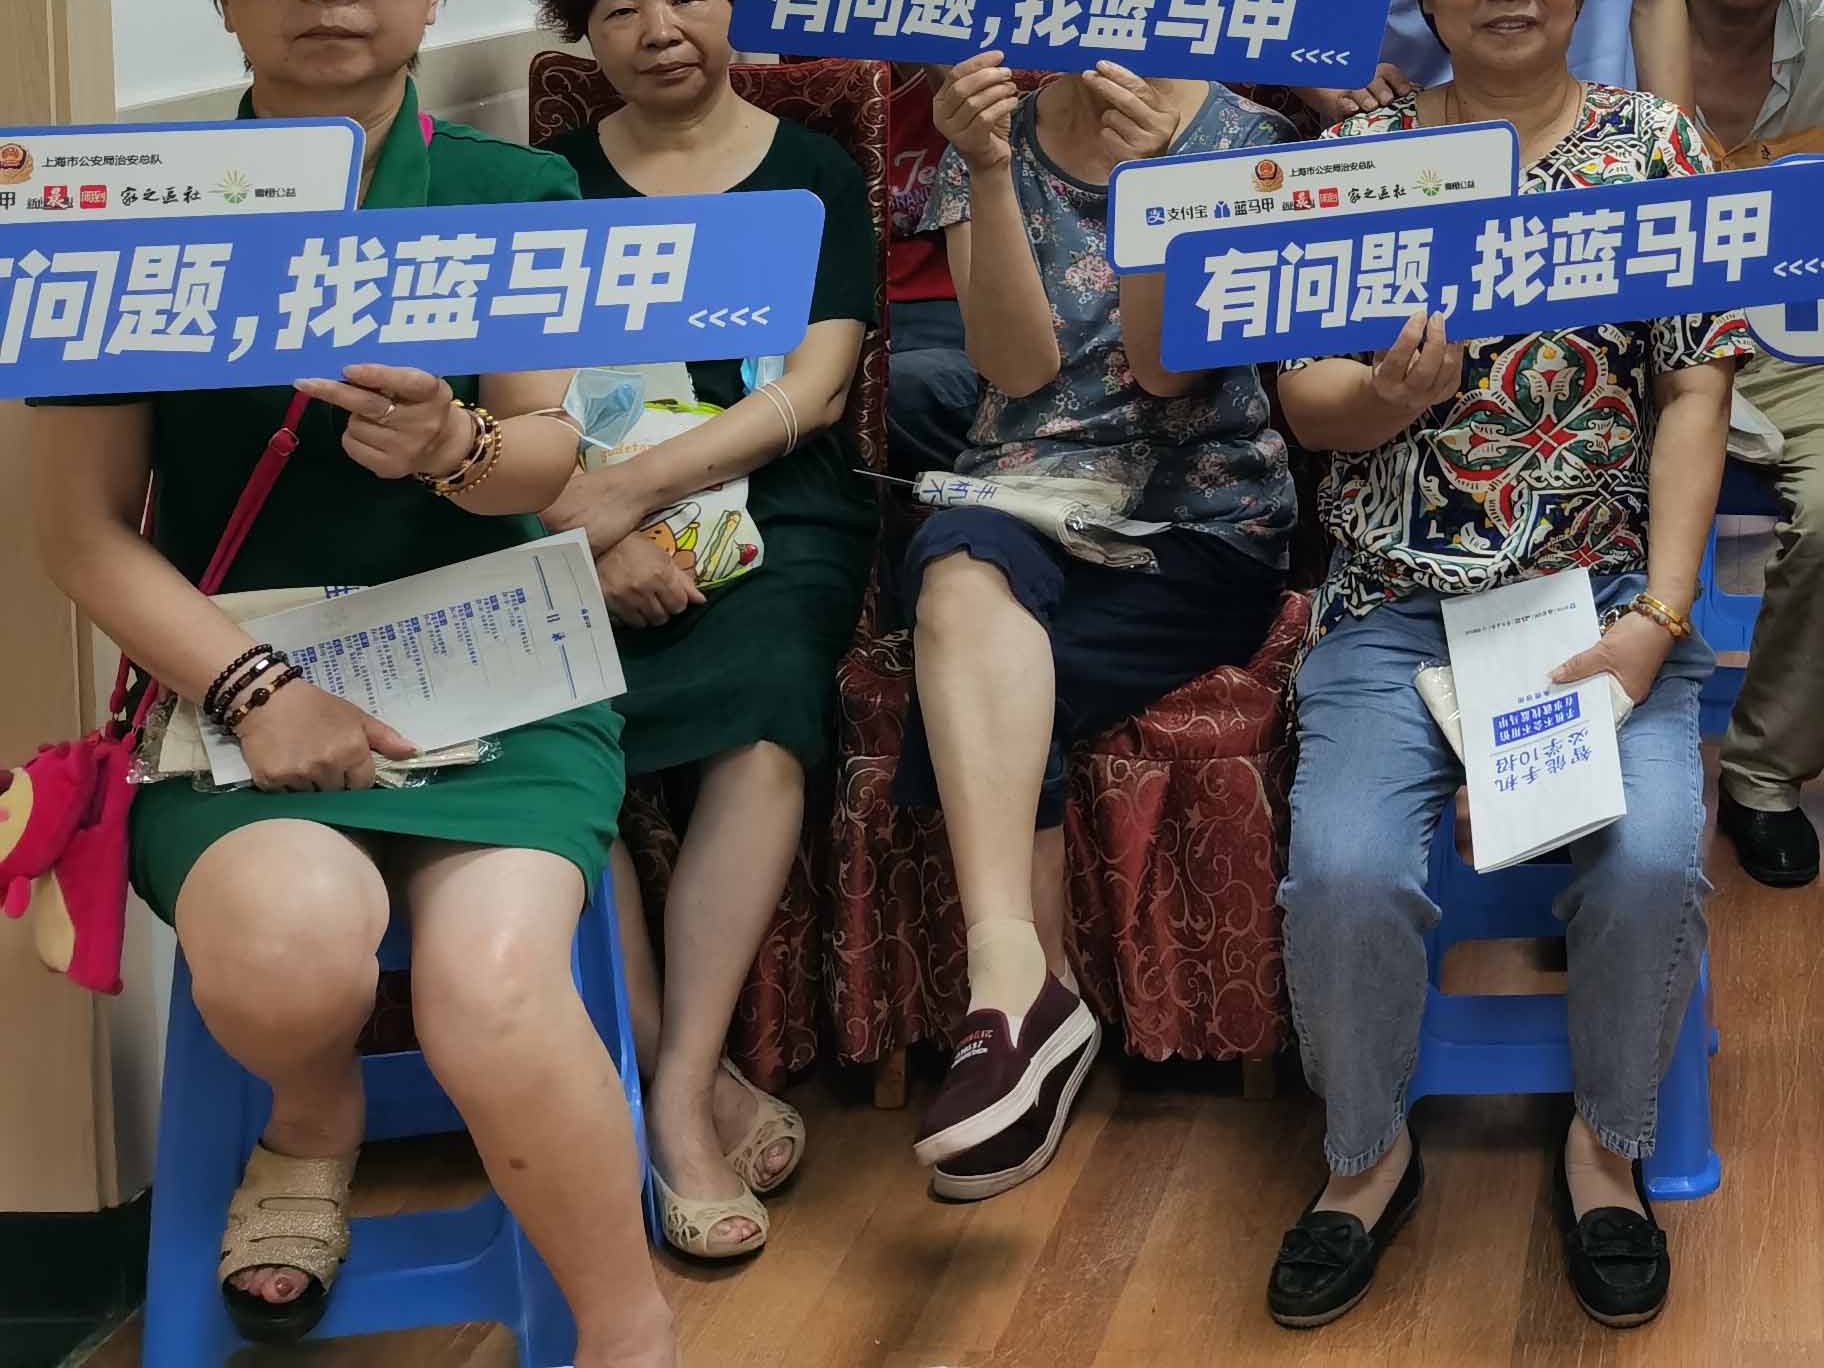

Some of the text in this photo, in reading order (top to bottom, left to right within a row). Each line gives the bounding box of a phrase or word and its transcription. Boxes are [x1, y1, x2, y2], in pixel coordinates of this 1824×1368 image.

[41, 153, 164, 169] 上海市公安局治安总队
[1288, 160, 1376, 178] 上海市公安局治安总队
[1167, 204, 1208, 222] 支付宝
[1234, 197, 1275, 217] 蓝马甲
[0, 223, 697, 364] 问题，找蓝马甲
[1495, 745, 1592, 792] 智能手机
[1496, 728, 1588, 774] 必学10招
